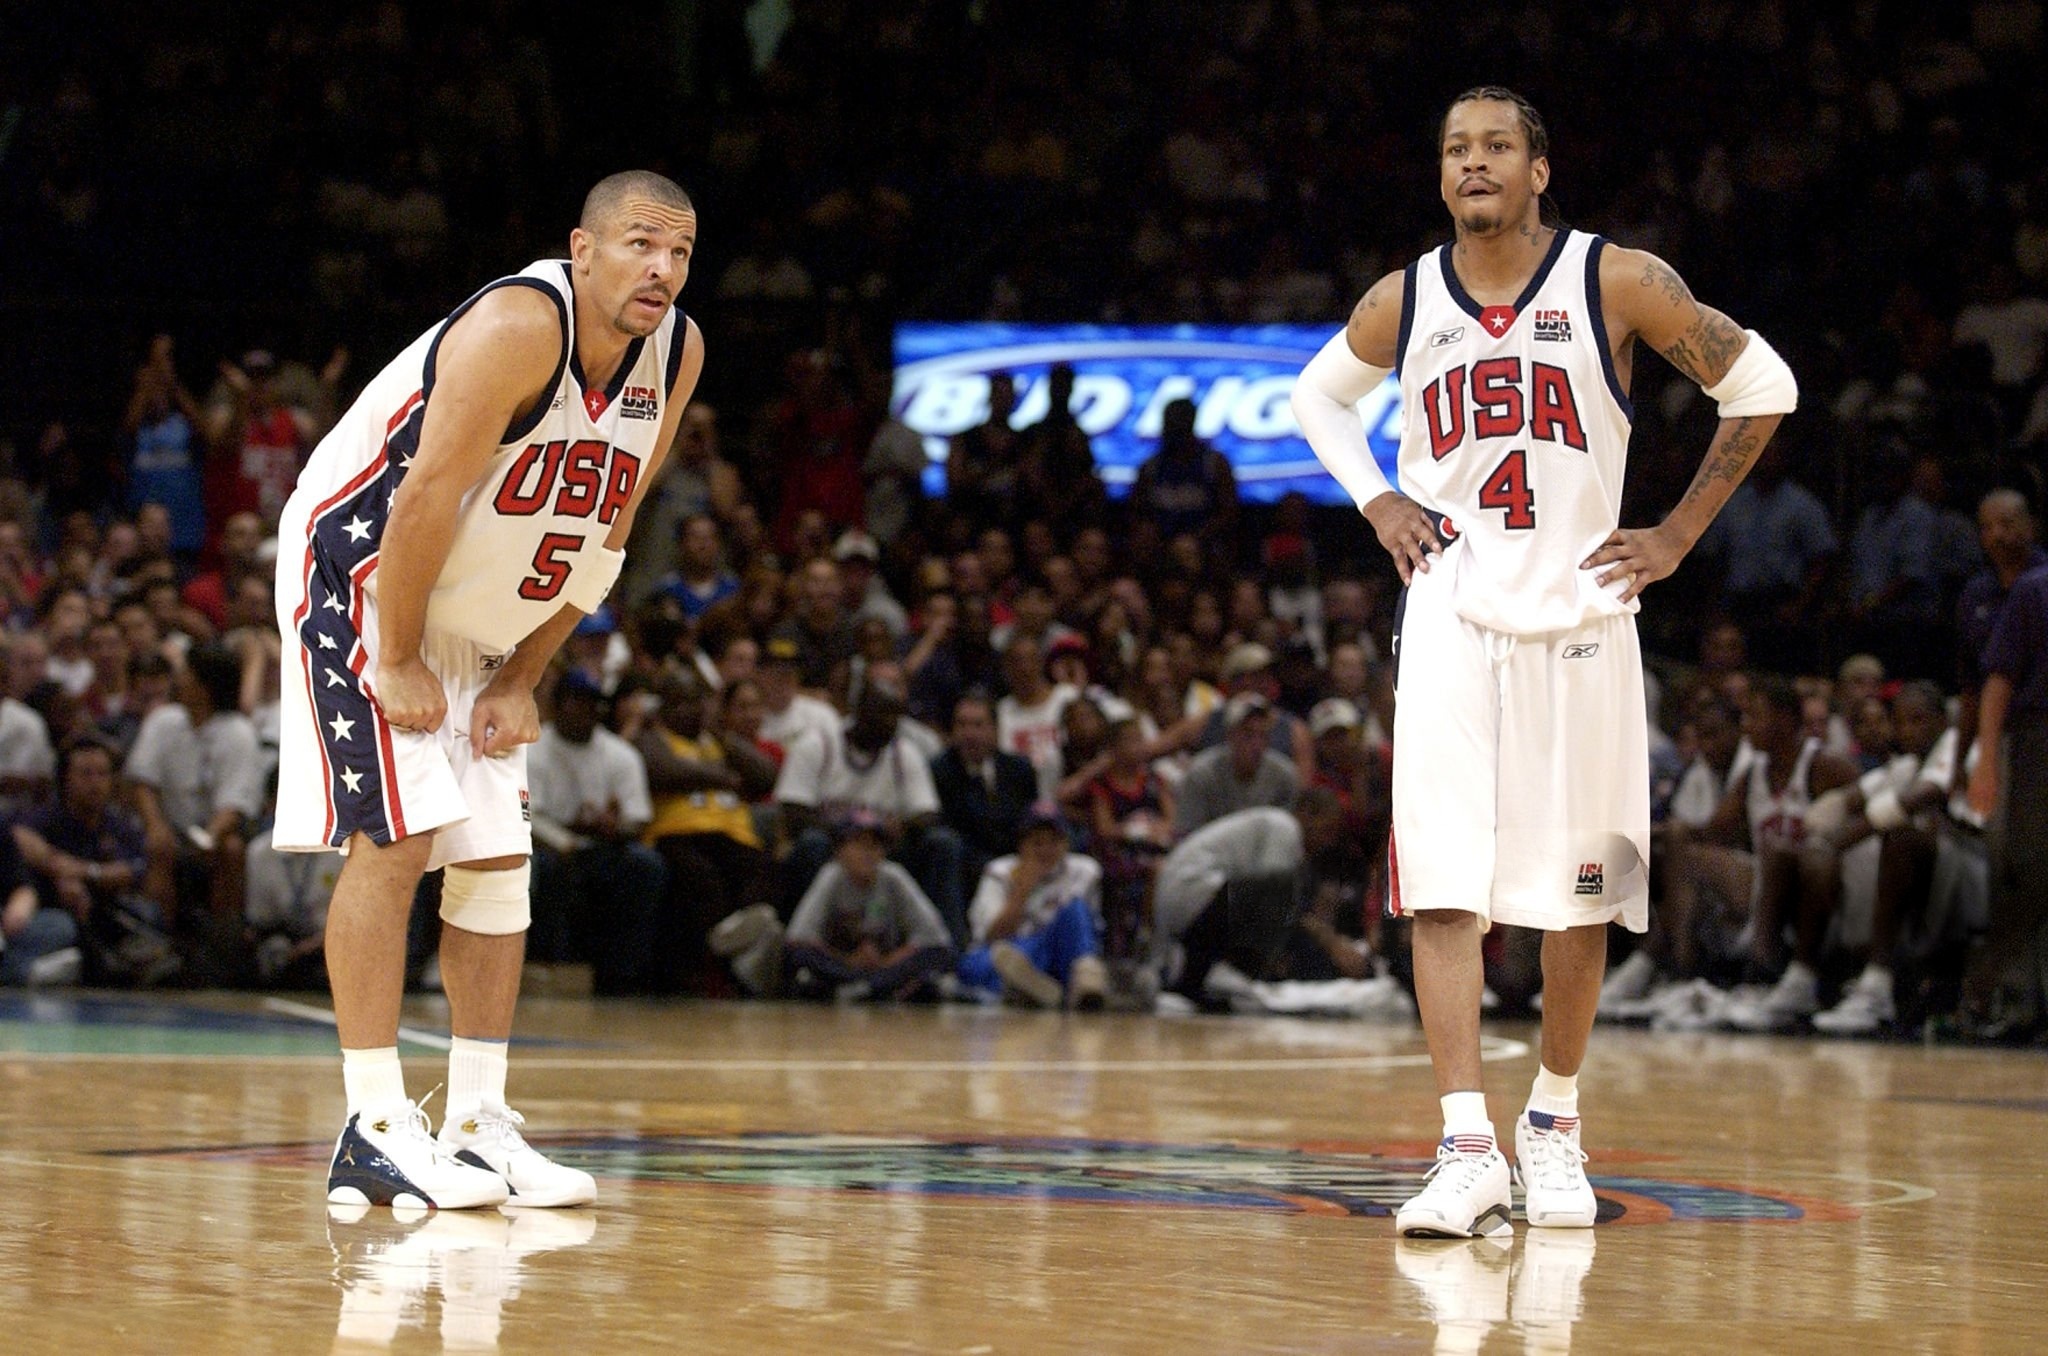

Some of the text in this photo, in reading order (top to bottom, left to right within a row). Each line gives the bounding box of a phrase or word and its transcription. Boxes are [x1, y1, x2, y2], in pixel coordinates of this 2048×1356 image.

[1534, 310, 1571, 331] USA
[622, 386, 657, 410] USA
[1422, 357, 1588, 461] USA
[493, 440, 640, 525] USA
[1479, 450, 1535, 530] 4
[518, 532, 585, 601] 5
